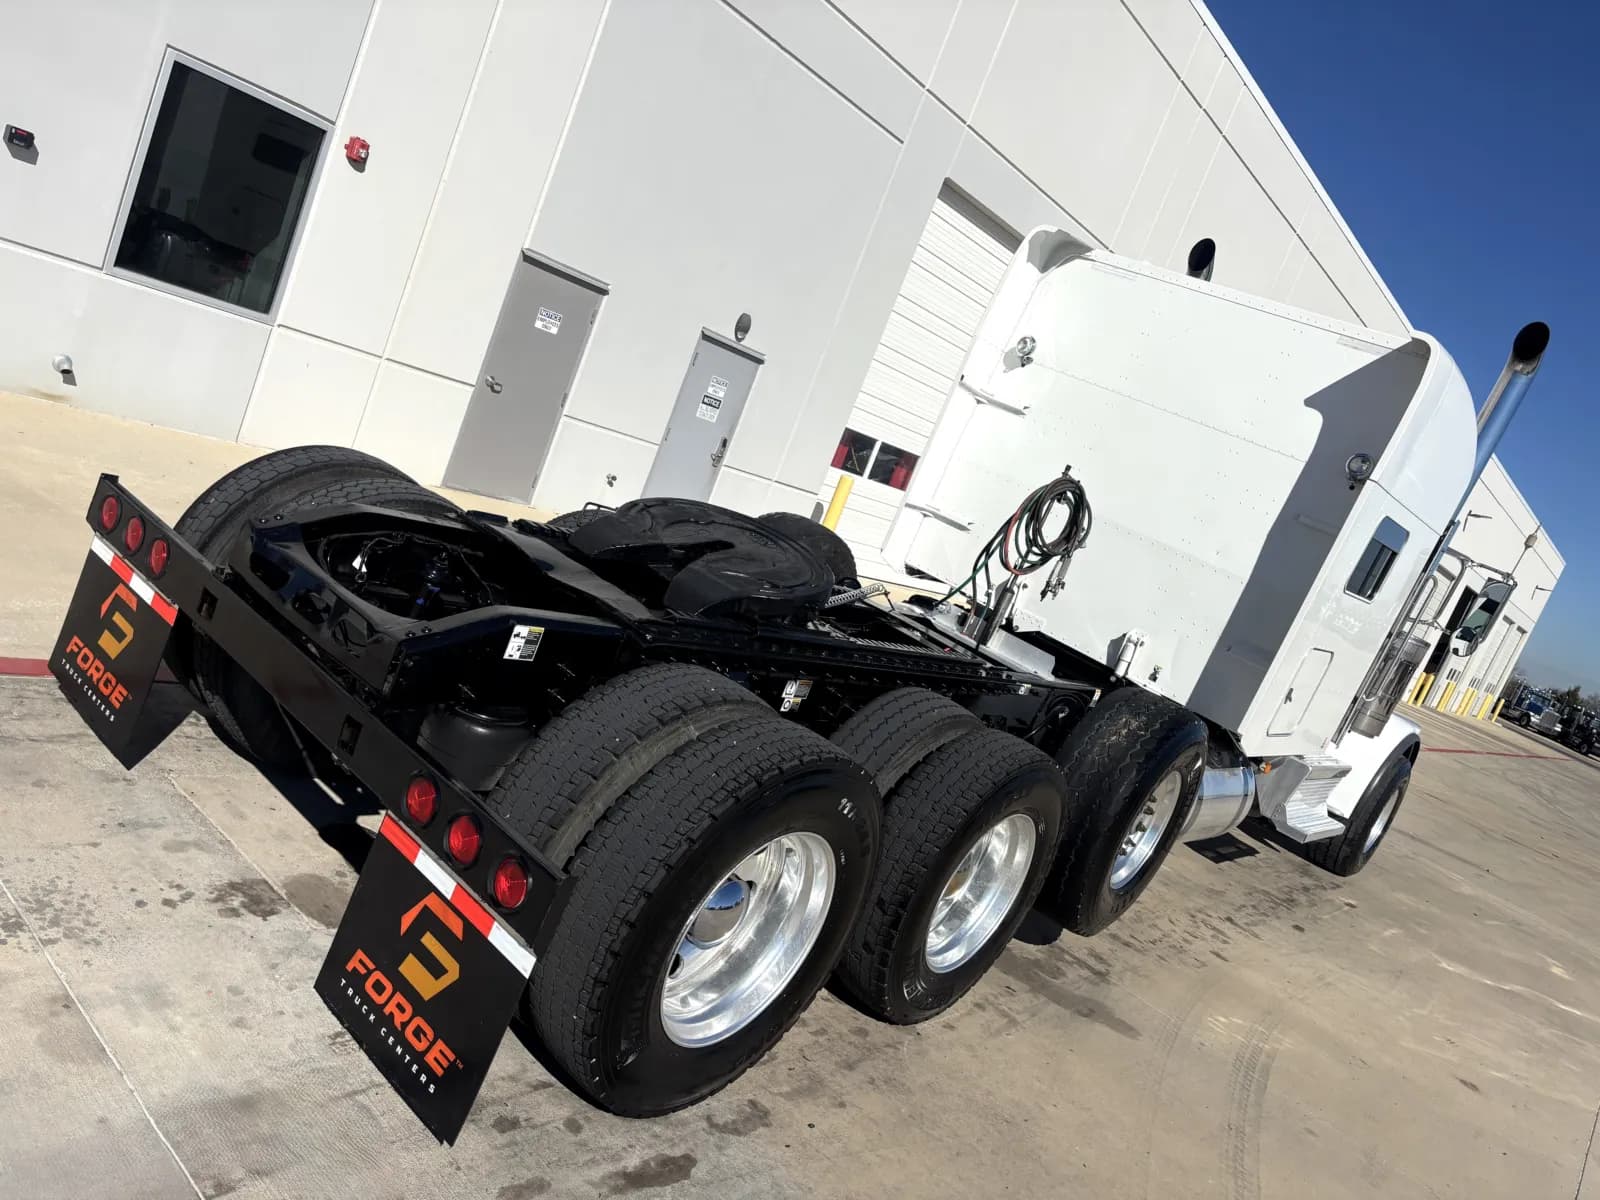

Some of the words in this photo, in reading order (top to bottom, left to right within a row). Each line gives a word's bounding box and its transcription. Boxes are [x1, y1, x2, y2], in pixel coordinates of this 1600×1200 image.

[540, 308, 562, 322] NOTICE
[61, 658, 82, 686] TRUCK
[83, 685, 116, 723] CENTERS
[65, 634, 129, 710] FORGE
[340, 977, 376, 1023] TRUCK
[380, 1027, 436, 1094] CENTERS
[345, 948, 456, 1078] FORGE
